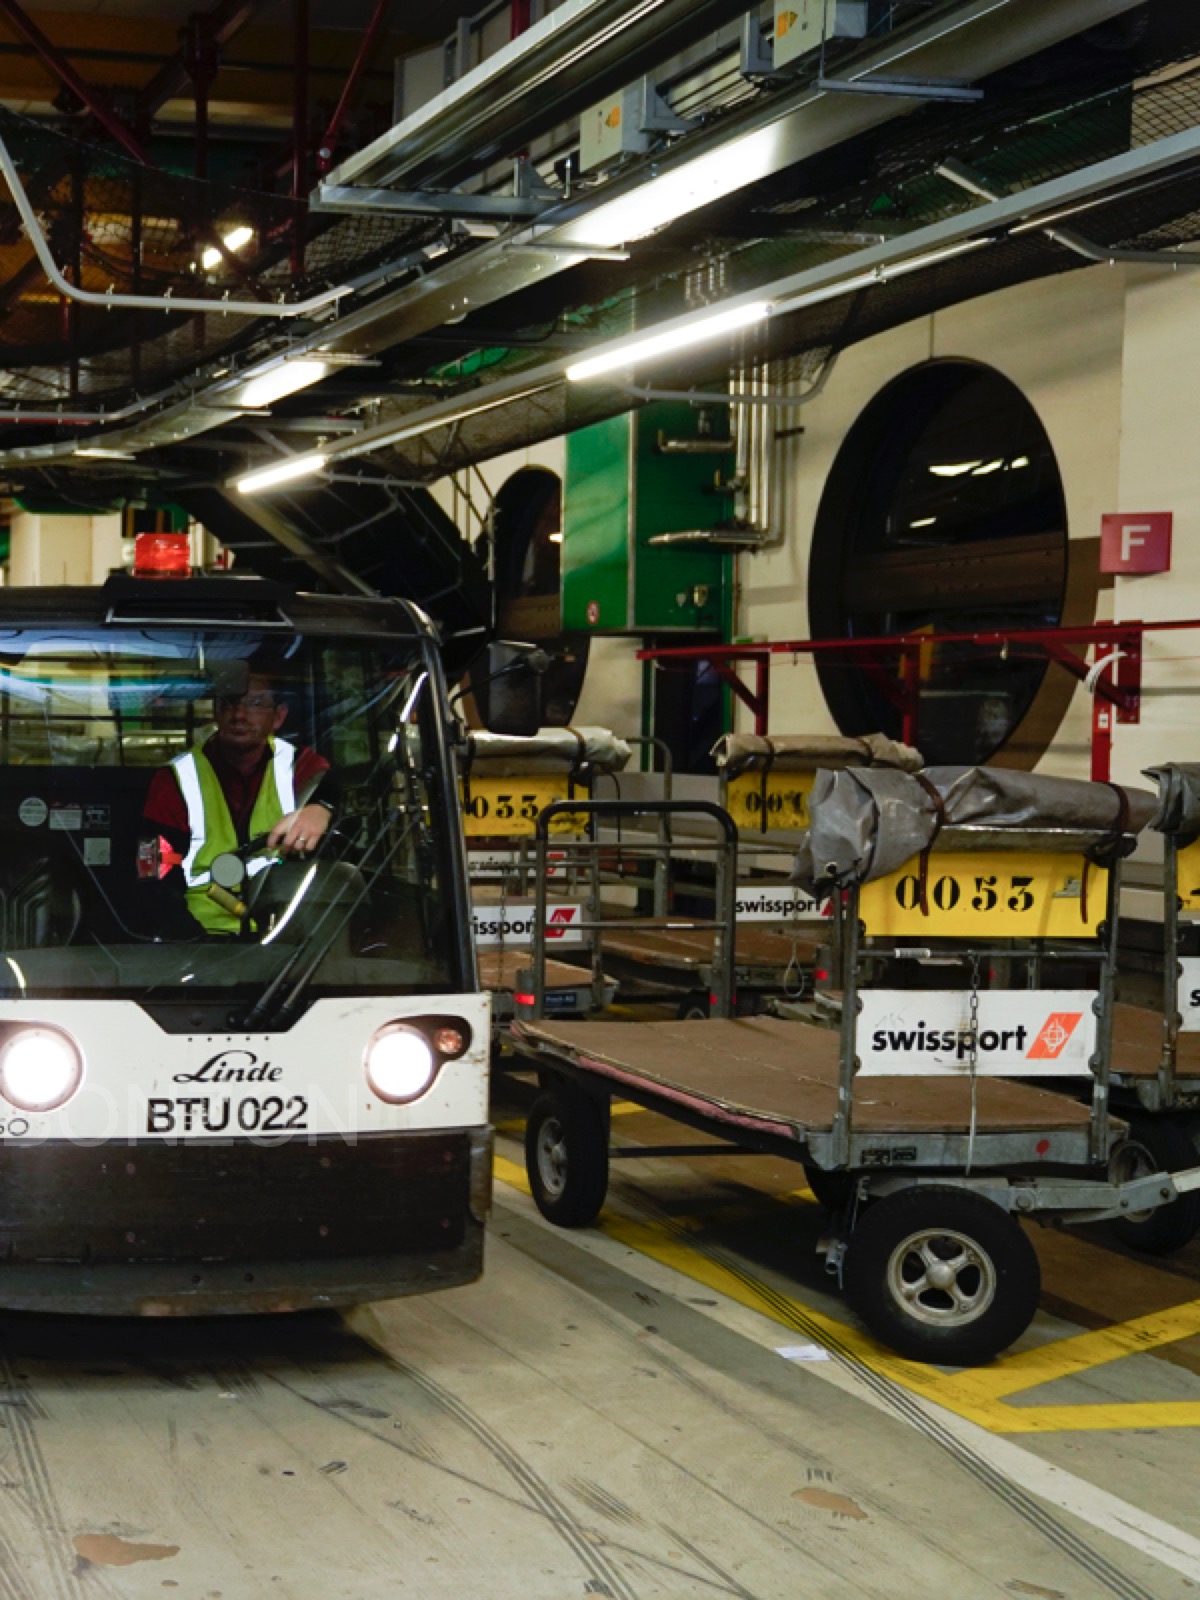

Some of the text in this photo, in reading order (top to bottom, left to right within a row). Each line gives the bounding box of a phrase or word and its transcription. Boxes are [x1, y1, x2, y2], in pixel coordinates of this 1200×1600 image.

[1122, 525, 1150, 561] F
[895, 875, 1035, 912] 0053
[871, 1020, 1028, 1059] swissport
[172, 1049, 282, 1083] Linde
[146, 1095, 309, 1132] BTU 022
